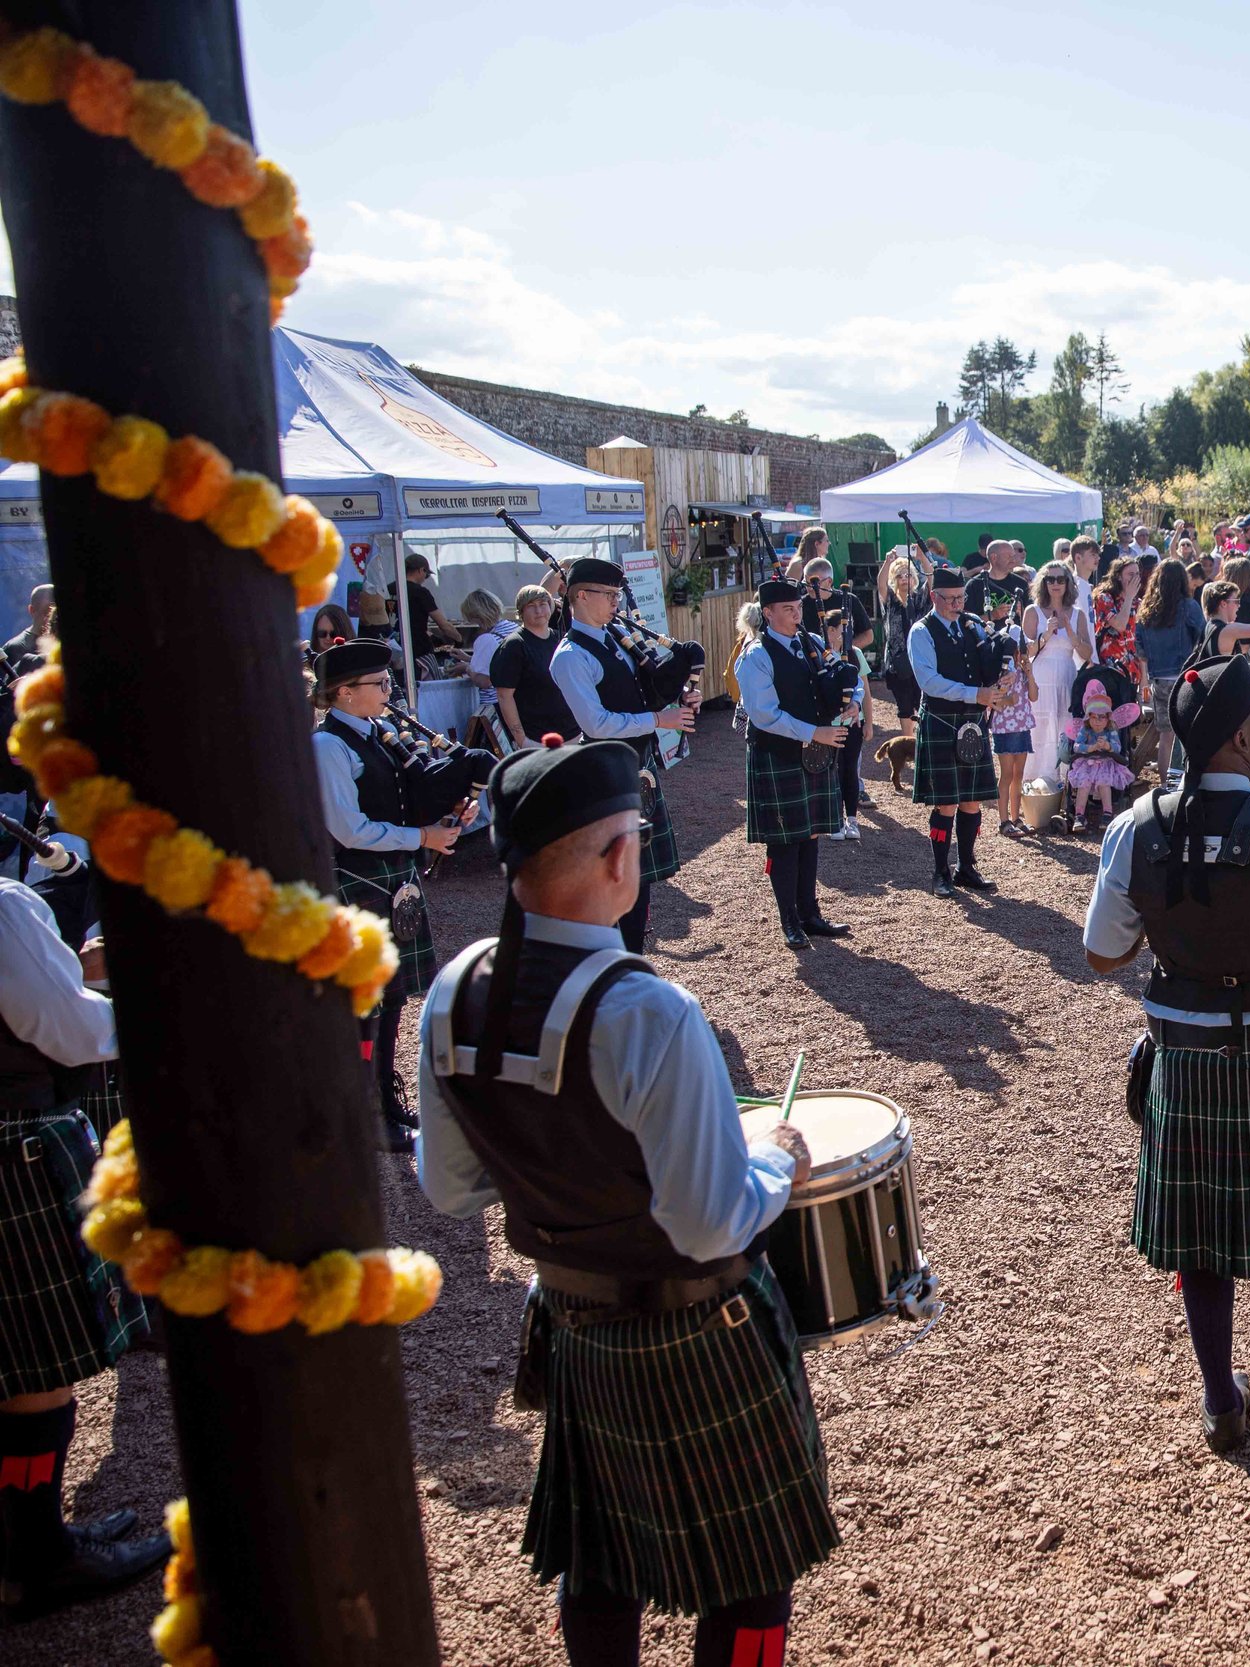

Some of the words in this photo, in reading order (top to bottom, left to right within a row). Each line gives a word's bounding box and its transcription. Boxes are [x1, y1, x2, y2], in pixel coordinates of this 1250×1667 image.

[419, 497, 469, 508] NEAPOLITAN
[471, 496, 505, 507] INSPIRED
[508, 495, 528, 506] PIZZA
[10, 506, 29, 516] BY
